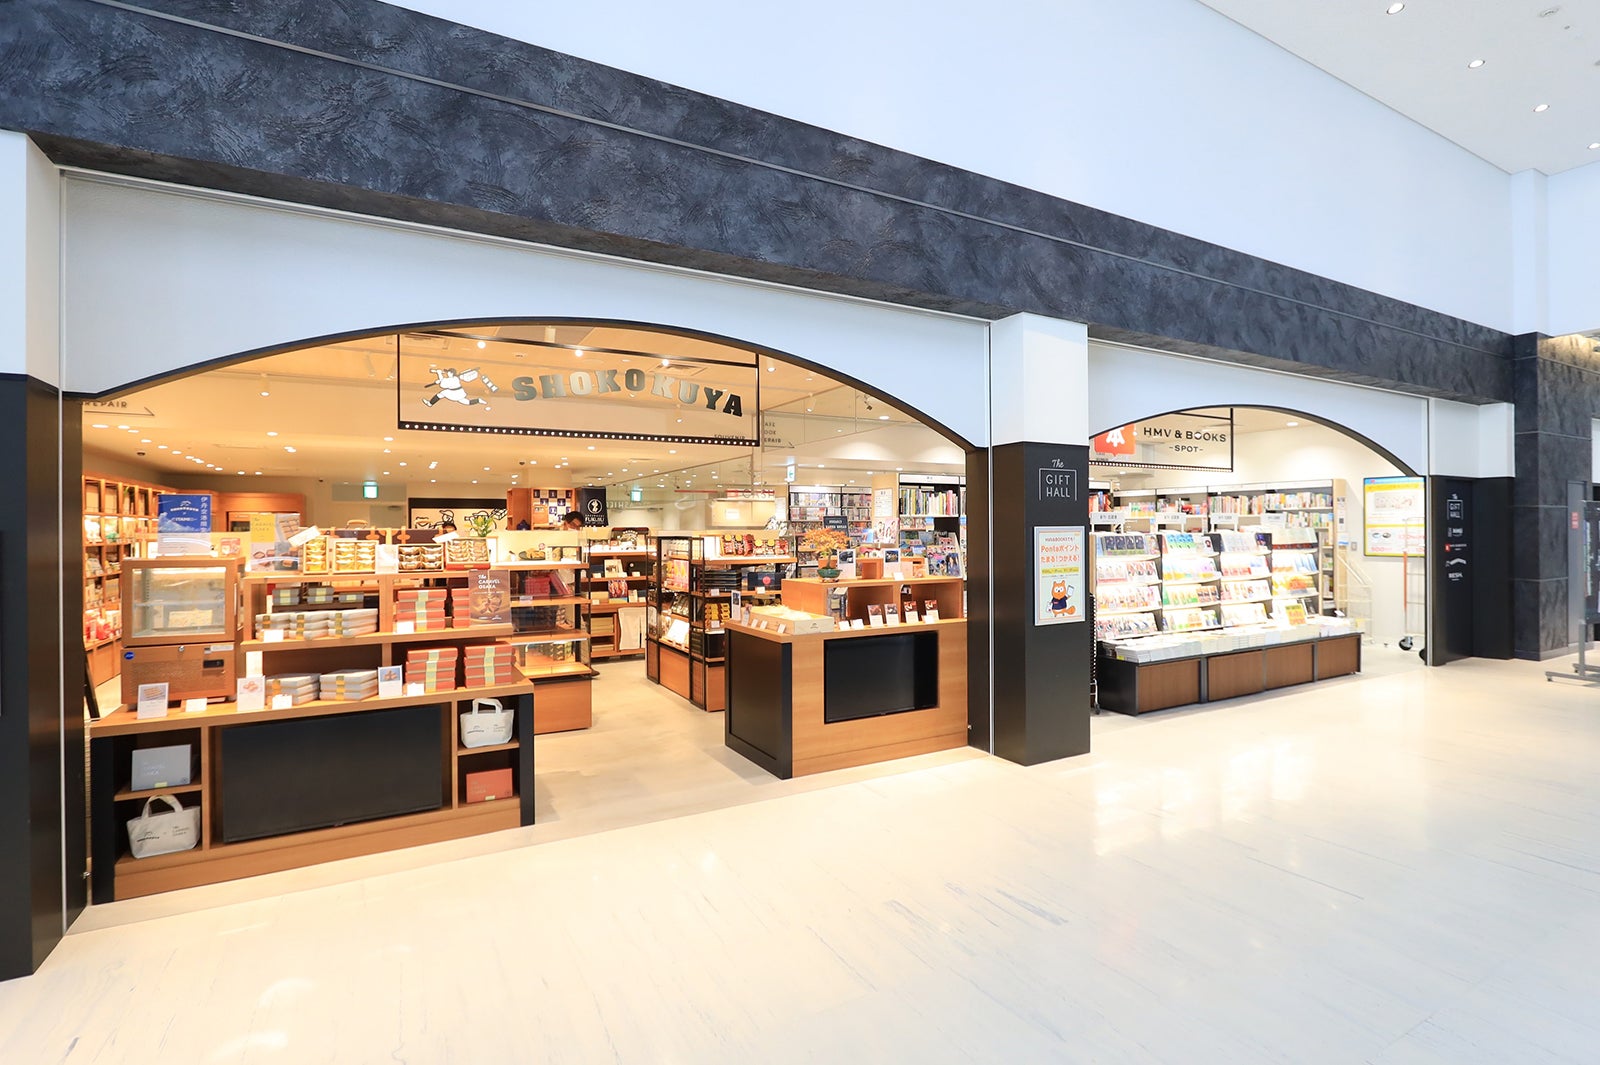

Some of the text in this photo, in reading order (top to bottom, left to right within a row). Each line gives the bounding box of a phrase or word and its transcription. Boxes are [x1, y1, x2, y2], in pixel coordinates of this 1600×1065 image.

[511, 368, 743, 418] SHOKOKUYA
[1143, 426, 1227, 443] HMV & BOOKS
[1051, 458, 1065, 468] The
[1045, 474, 1071, 485] GIFT
[1046, 486, 1071, 498] HALL
